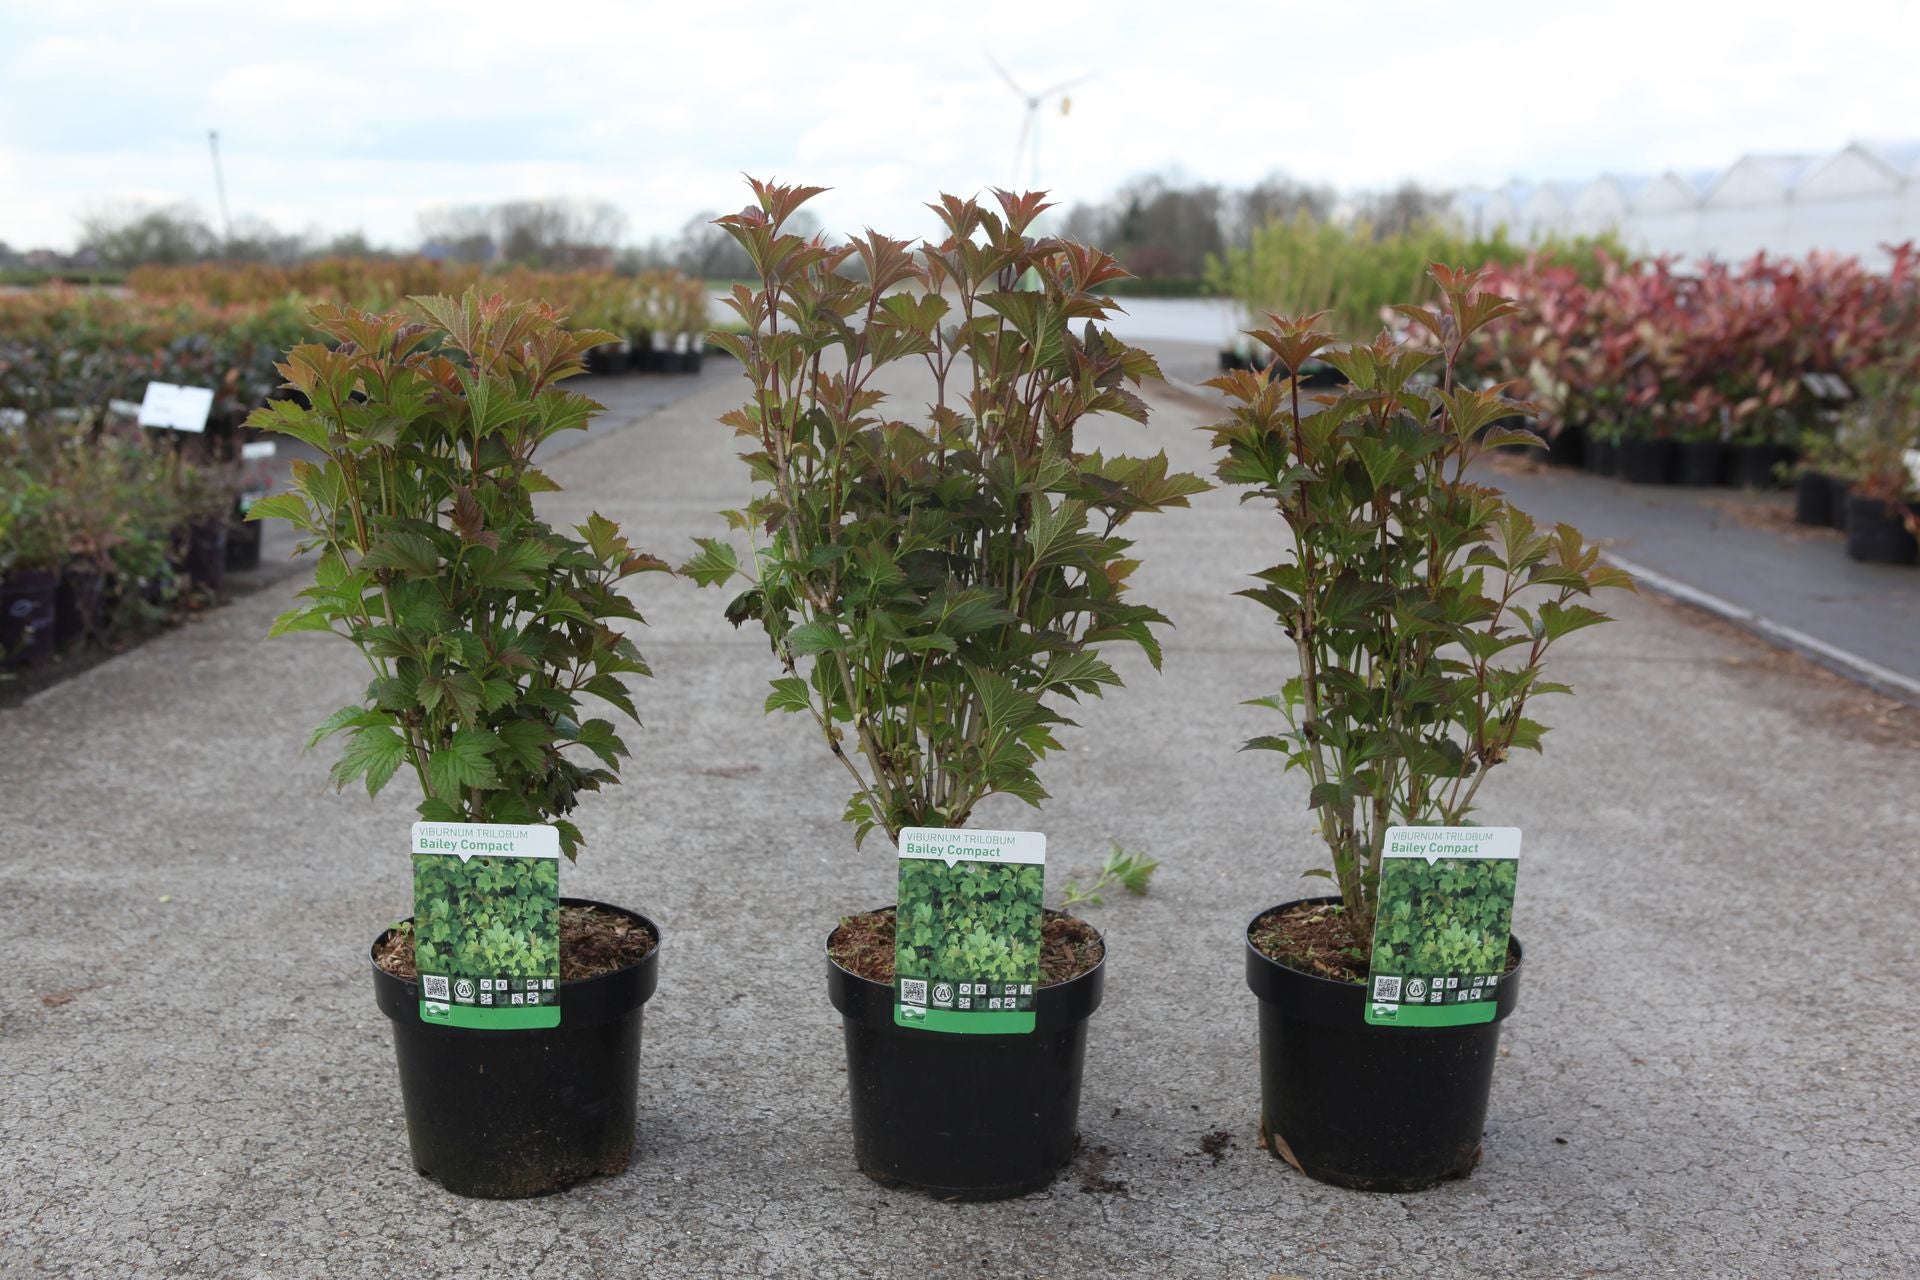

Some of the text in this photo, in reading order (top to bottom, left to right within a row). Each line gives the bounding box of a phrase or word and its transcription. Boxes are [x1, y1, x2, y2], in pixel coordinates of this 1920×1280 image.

[419, 827, 528, 839] VIBURNUM TRILOBUM
[906, 832, 1016, 845] VIBURNUM TRILOBUM
[1392, 831, 1494, 841] VIBURNUM TRILOBUM
[420, 838, 515, 852] Bailey Compact
[906, 843, 1001, 858] Bailey Compact
[1391, 842, 1480, 855] Bailey Compact
